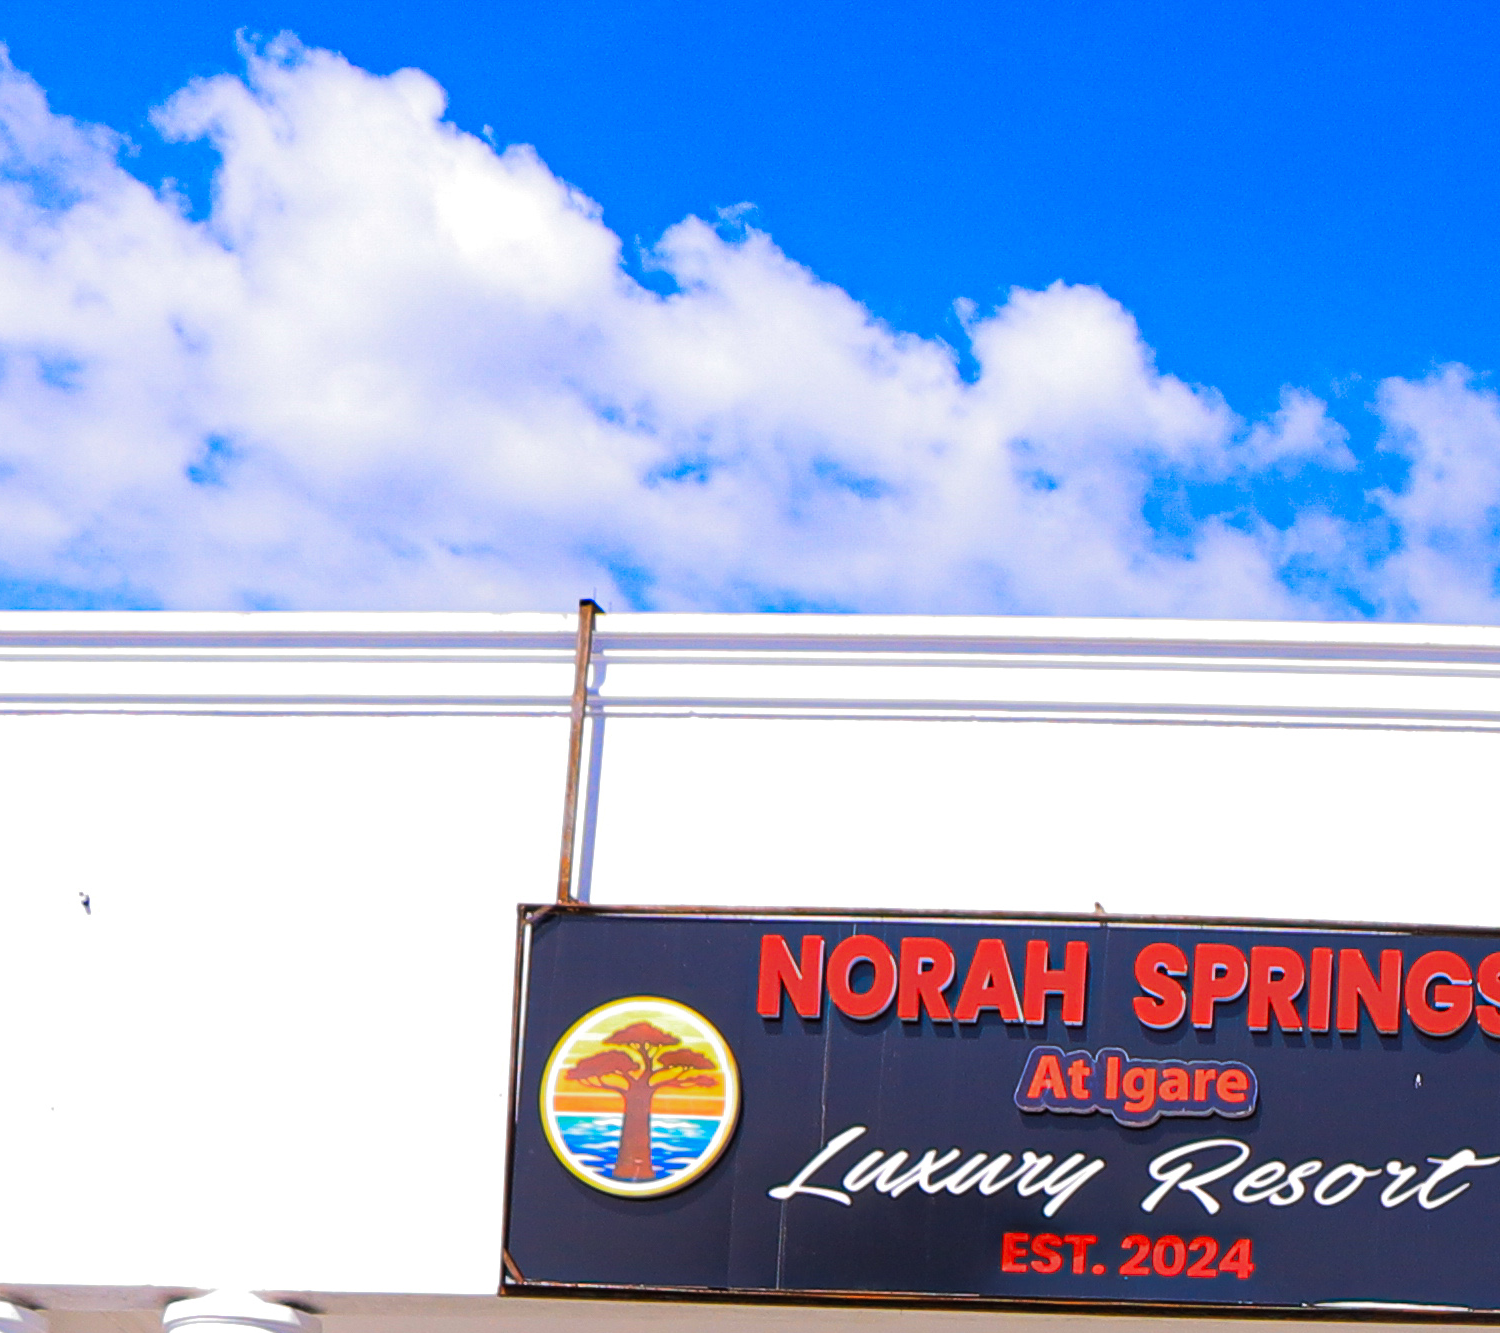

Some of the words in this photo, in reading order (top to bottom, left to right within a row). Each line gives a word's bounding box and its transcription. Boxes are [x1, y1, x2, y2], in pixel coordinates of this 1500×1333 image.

[757, 934, 1088, 1026] NORAH
[1026, 1055, 1091, 1099] At
[1105, 1056, 1248, 1113] Igare
[768, 1126, 1105, 1217] Luxury
[1141, 1139, 1500, 1214] Resort
[1001, 1232, 1106, 1274] EST.
[1119, 1234, 1255, 1279] 2024
